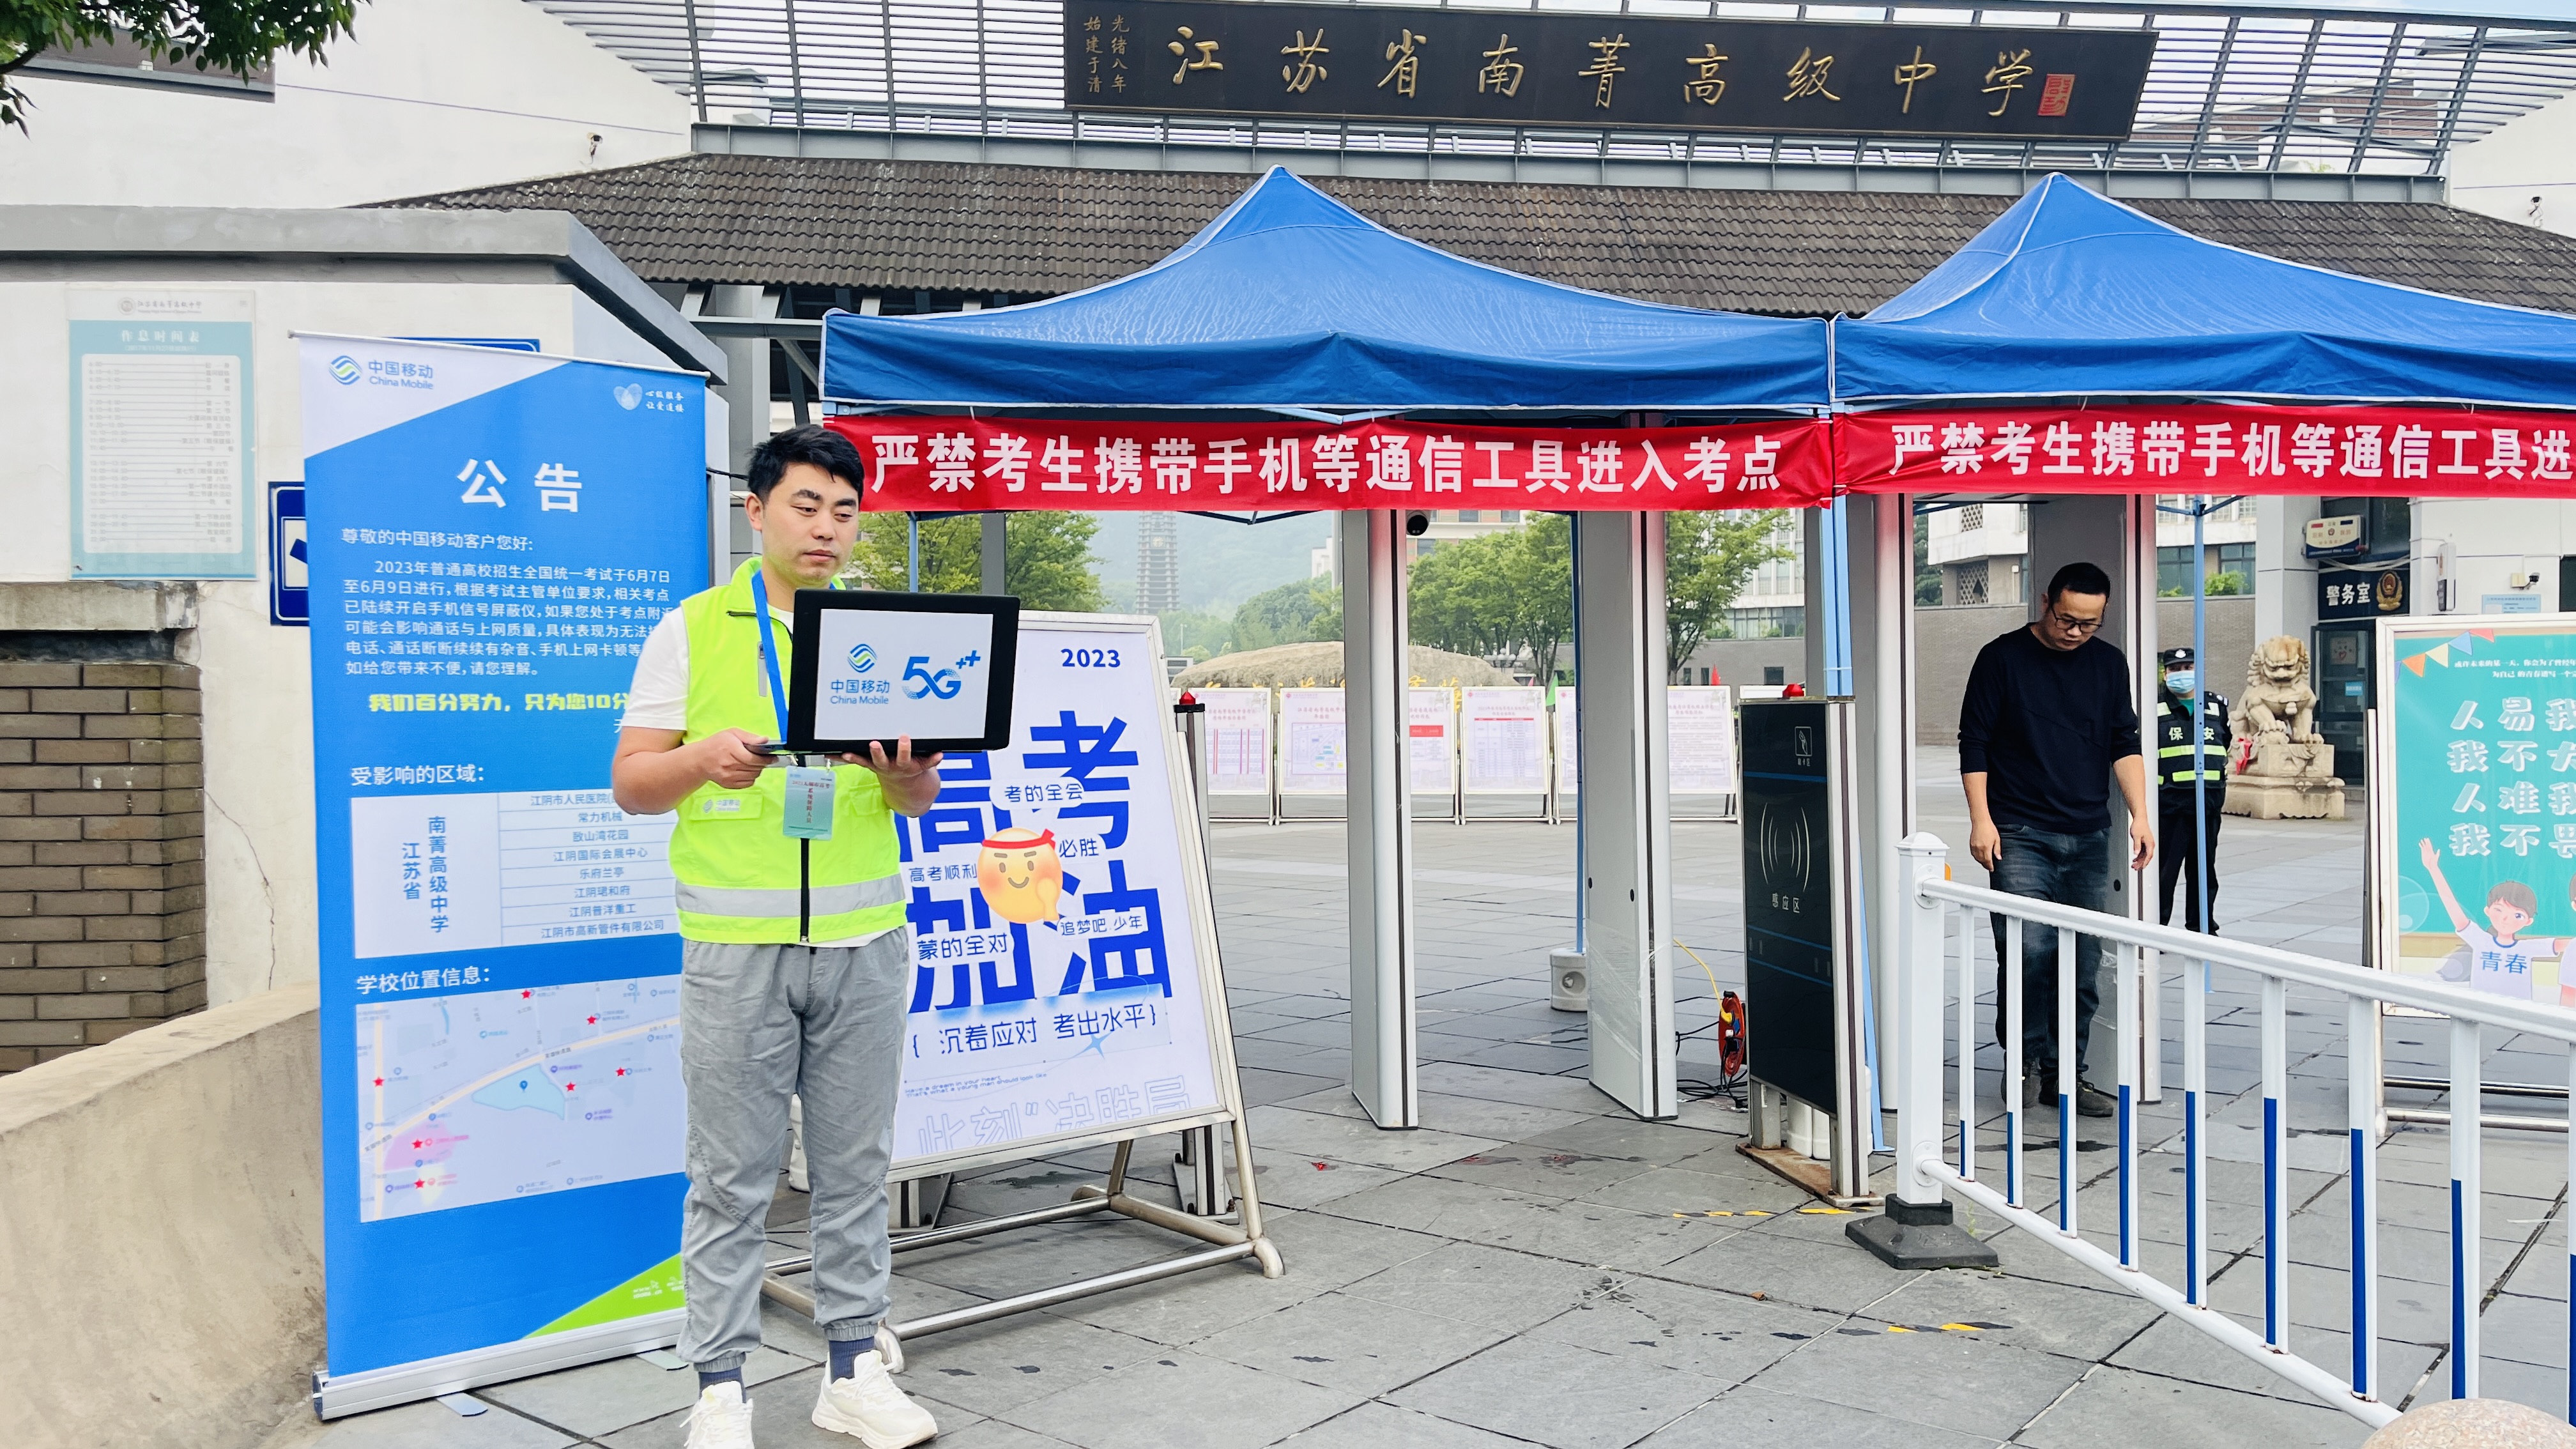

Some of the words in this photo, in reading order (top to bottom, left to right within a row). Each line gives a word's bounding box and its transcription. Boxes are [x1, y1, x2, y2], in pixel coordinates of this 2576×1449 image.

[1084, 16, 1103, 93] 始建于清
[1112, 14, 1130, 93] 光绪八年
[1168, 26, 2033, 117] 江苏省南菁高级中学
[121, 330, 200, 342] 作息时间表
[368, 360, 433, 379] 中国移动
[369, 376, 399, 387] China
[401, 378, 434, 390] Mobile
[1888, 420, 2575, 480] 严禁考生携带手机等通信工具进
[870, 431, 1782, 495] 严禁考生携带手机等通信工具进入考点
[457, 458, 583, 513] 公告
[374, 560, 670, 583] 2023年普通高校招生全国统一考试于6月7日
[2326, 582, 2371, 606] 警务室
[345, 660, 538, 676] 如给您带来不便，请您理解。
[1061, 648, 1121, 668] 2023
[831, 678, 890, 694] 中国移动
[830, 695, 857, 705] China
[859, 696, 889, 705] Mobile
[2450, 696, 2576, 732] 人易我
[351, 763, 484, 786] 受影响的区域：
[1004, 783, 1084, 803] 考的全会
[2452, 780, 2576, 816] 人难我
[578, 811, 623, 823] 常力机械
[553, 847, 648, 862] 江阴国际会展中心
[1059, 838, 1100, 858] 必胜
[402, 842, 422, 900] 江苏省
[427, 815, 449, 933] 南菁高级中学
[579, 867, 625, 880] 乐府兰亭
[908, 863, 977, 882] 高考顺利
[1772, 893, 1800, 914] 感应区
[541, 919, 665, 939] 江阴市高新管件有限公司
[917, 932, 1008, 960] 蒙的全对
[2480, 951, 2527, 974] 青春
[356, 966, 491, 995] 学校位置信息：
